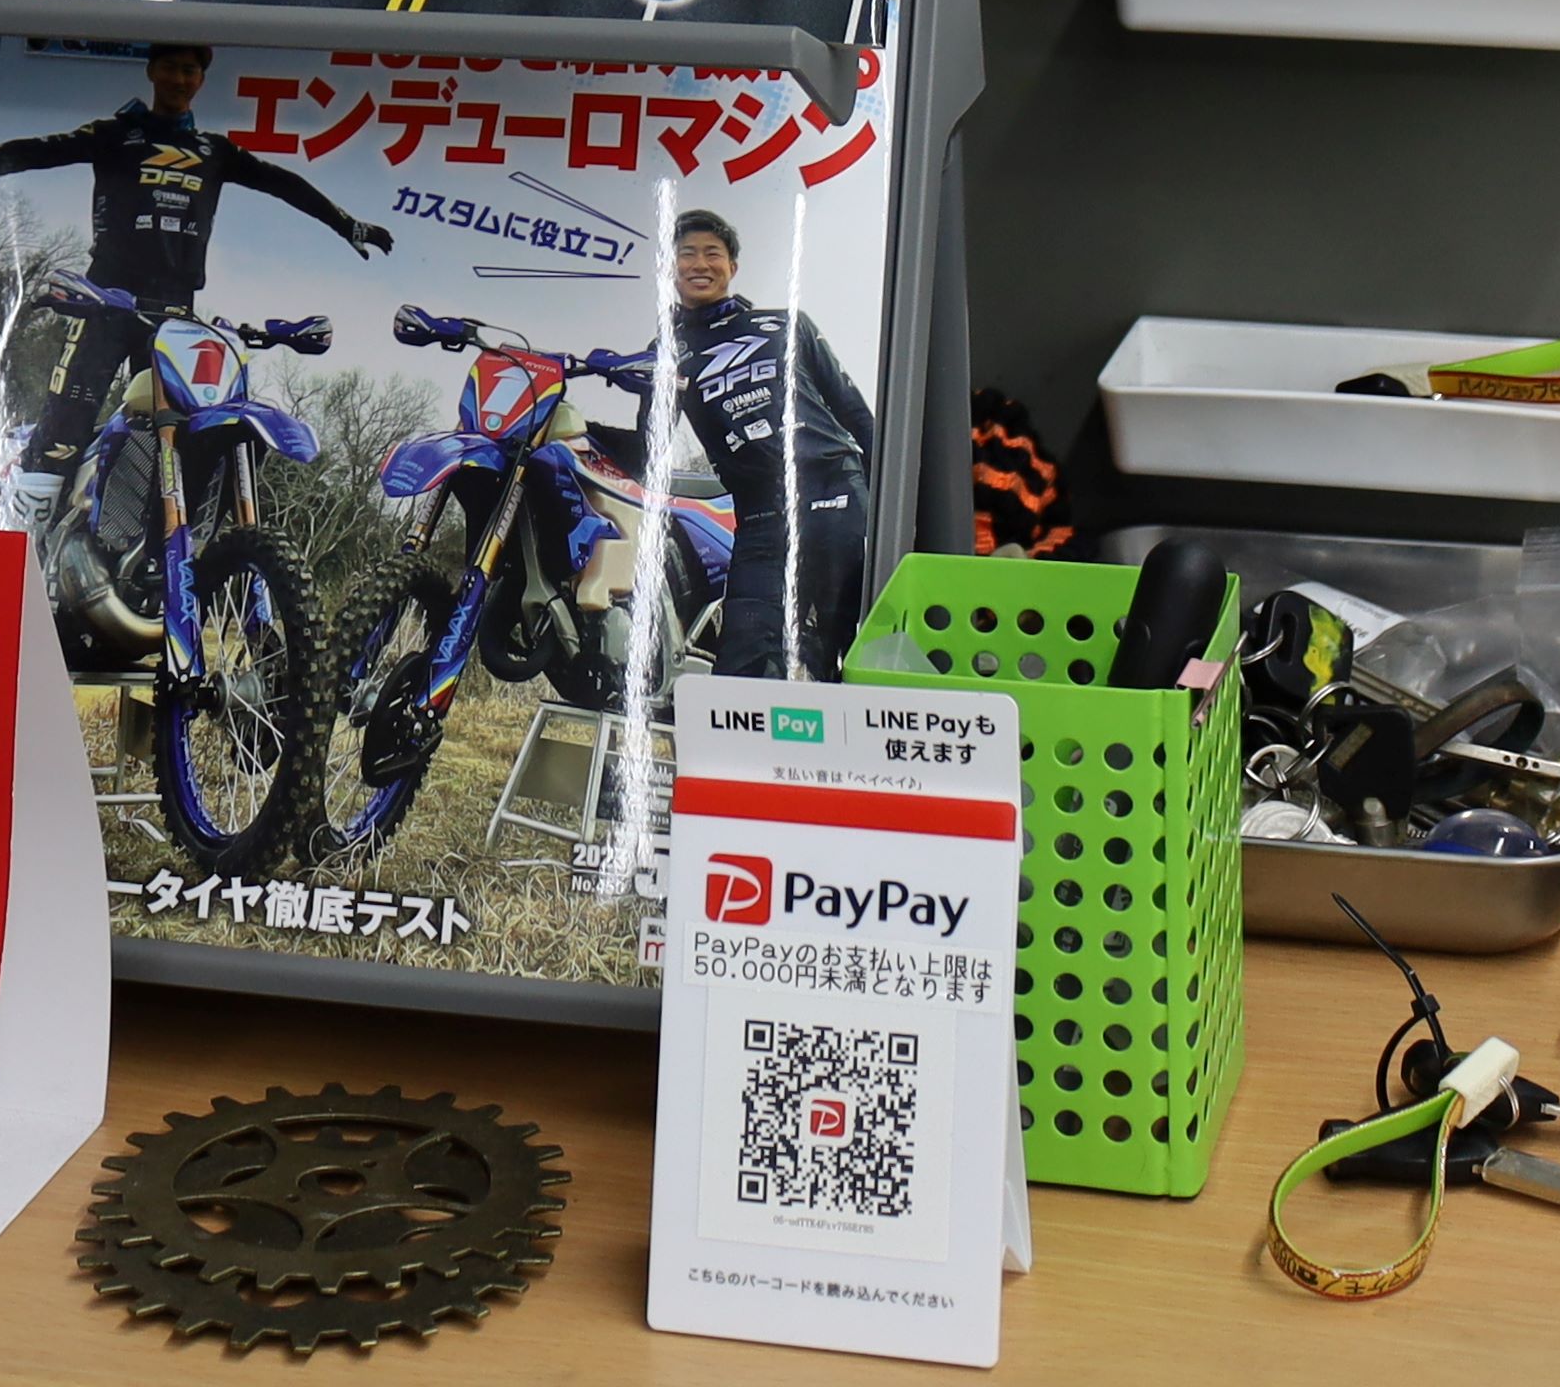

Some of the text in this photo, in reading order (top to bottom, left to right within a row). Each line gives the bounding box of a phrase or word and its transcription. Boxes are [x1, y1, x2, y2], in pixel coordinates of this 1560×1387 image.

[228, 75, 877, 189] エンデューロマシン
[139, 167, 203, 191] DFG
[391, 185, 636, 266] カスタムに役立つ!
[697, 359, 778, 403] DFG
[710, 709, 766, 734] LINE
[777, 713, 818, 739] Pay
[866, 709, 919, 733] LINE
[885, 738, 977, 765] 使えます
[785, 872, 970, 937] PayPay
[693, 931, 993, 981] PayPayのお支払い上限は
[688, 1268, 955, 1309] こちらのバーコードを読み込んでください
